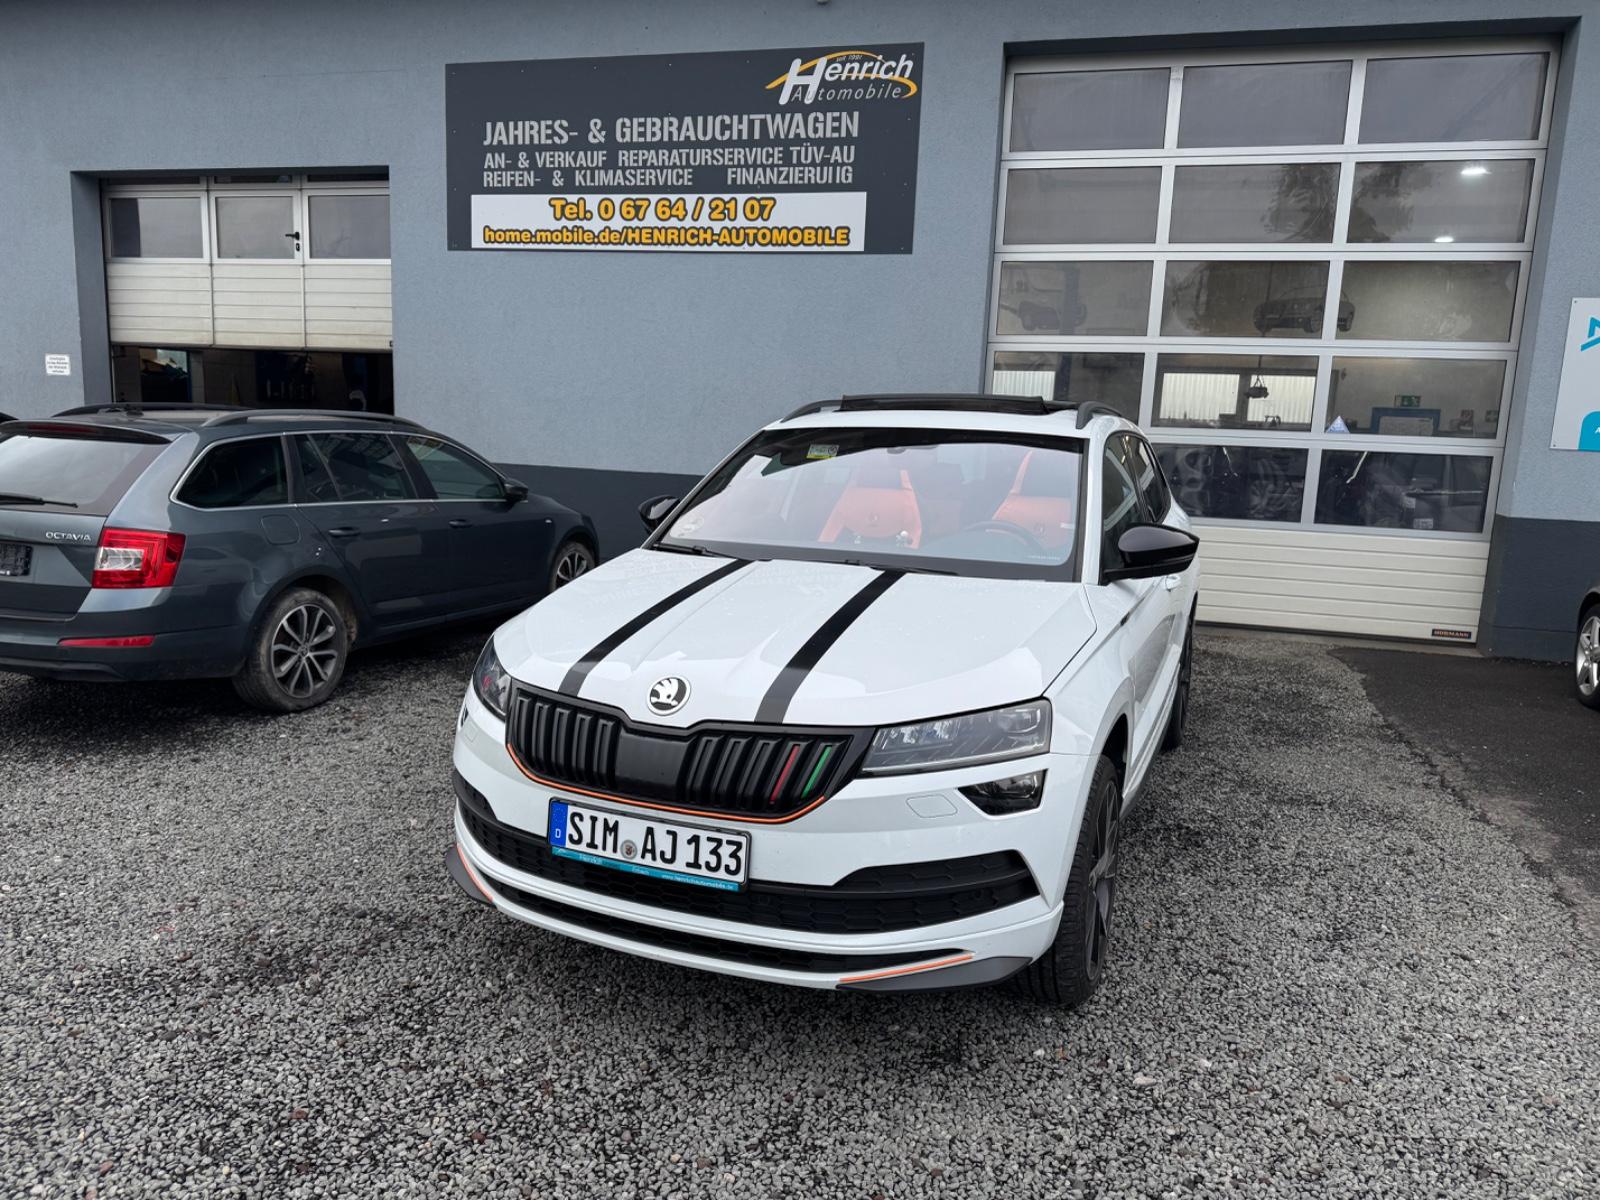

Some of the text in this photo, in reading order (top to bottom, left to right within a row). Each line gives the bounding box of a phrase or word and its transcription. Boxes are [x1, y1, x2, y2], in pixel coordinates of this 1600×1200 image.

[778, 53, 914, 105] Henrich
[483, 111, 859, 146] JAHRES- & GEBRAUCHTWAGEN
[484, 142, 855, 169] AN- & VERKAUF REPARATURSERVICE TÜV-AU
[483, 170, 541, 188] REIFEN-
[552, 169, 564, 187] &
[575, 168, 693, 187] KLIMASERVICE
[549, 197, 776, 222] Tel. 0 67 64 / 21 07
[483, 225, 851, 247] home.mobile.de/HENRICH-AUTOMOBILE
[45, 531, 91, 541] OCTAVIA
[554, 827, 561, 839] D
[568, 811, 744, 876] SIM AJ 133
